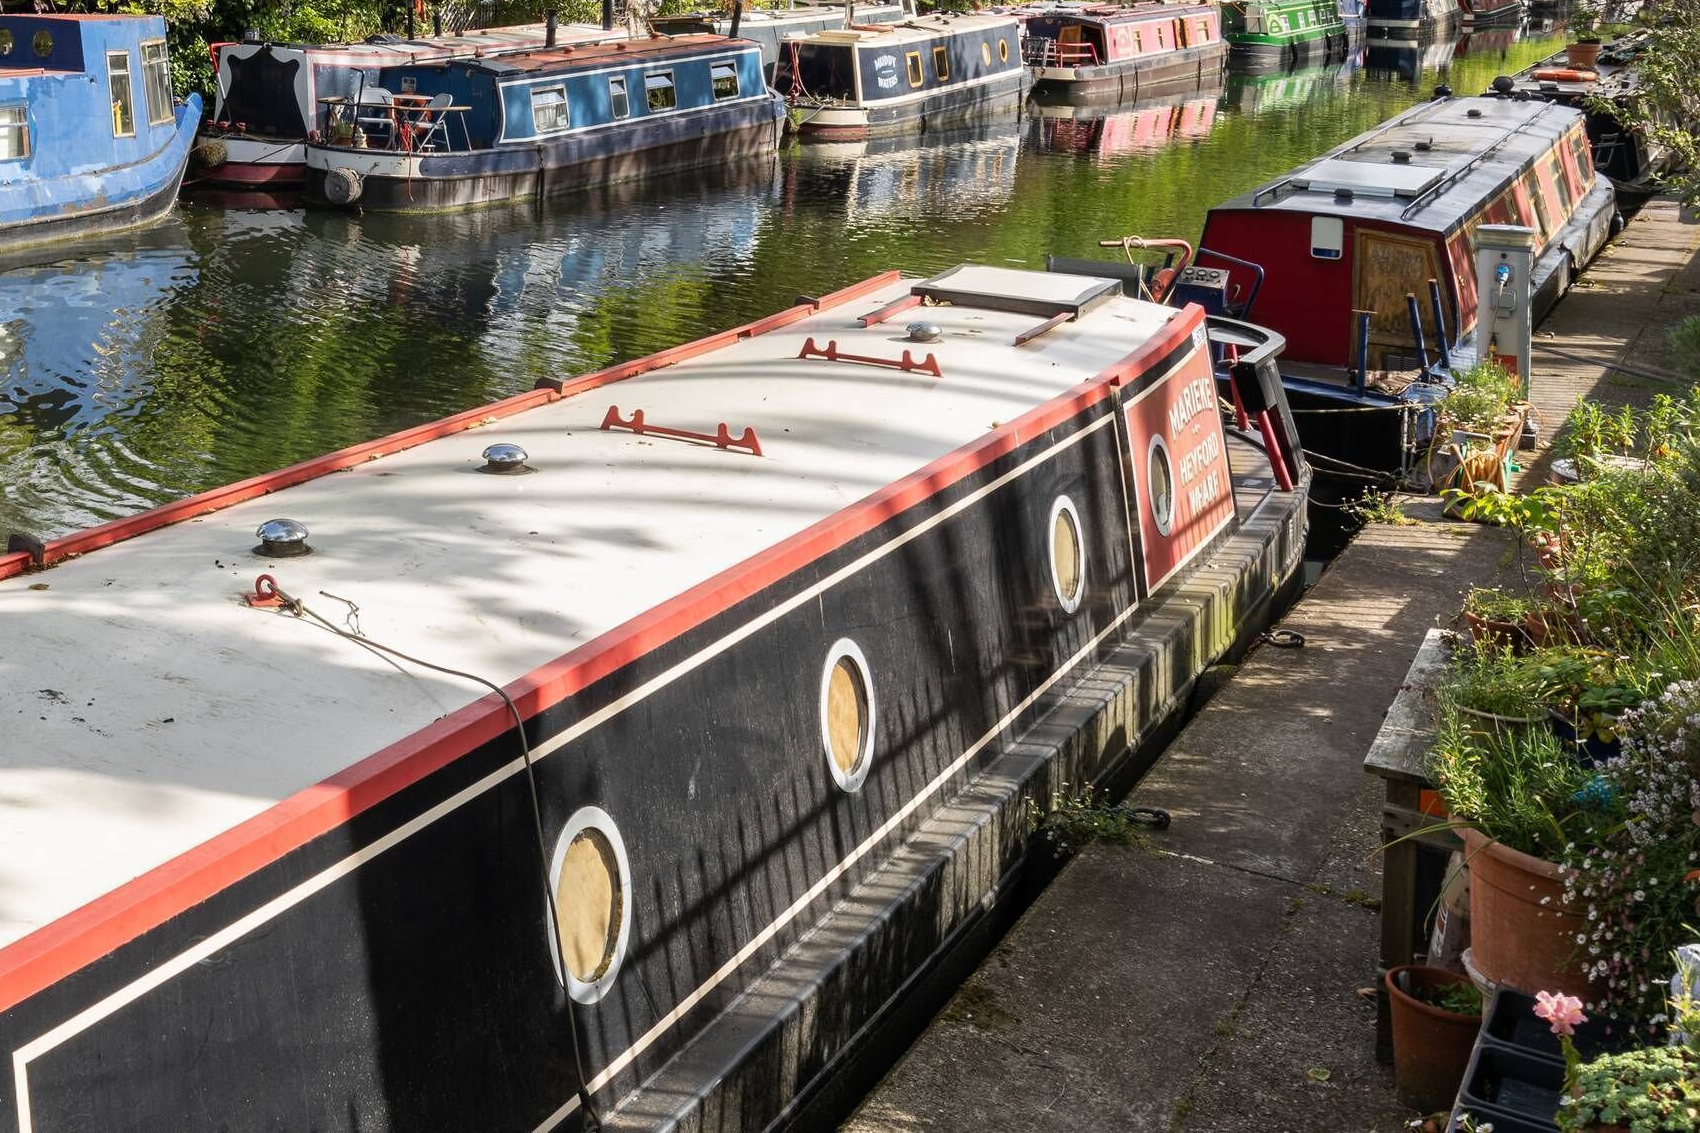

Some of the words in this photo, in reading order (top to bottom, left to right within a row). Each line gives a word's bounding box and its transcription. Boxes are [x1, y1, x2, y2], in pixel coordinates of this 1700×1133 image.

[874, 55, 897, 71] MUDDY
[877, 74, 898, 88] WATERS
[1169, 378, 1213, 441] MARIEKE
[1179, 432, 1219, 486] HEYFORD
[1188, 470, 1219, 515] WHARF
